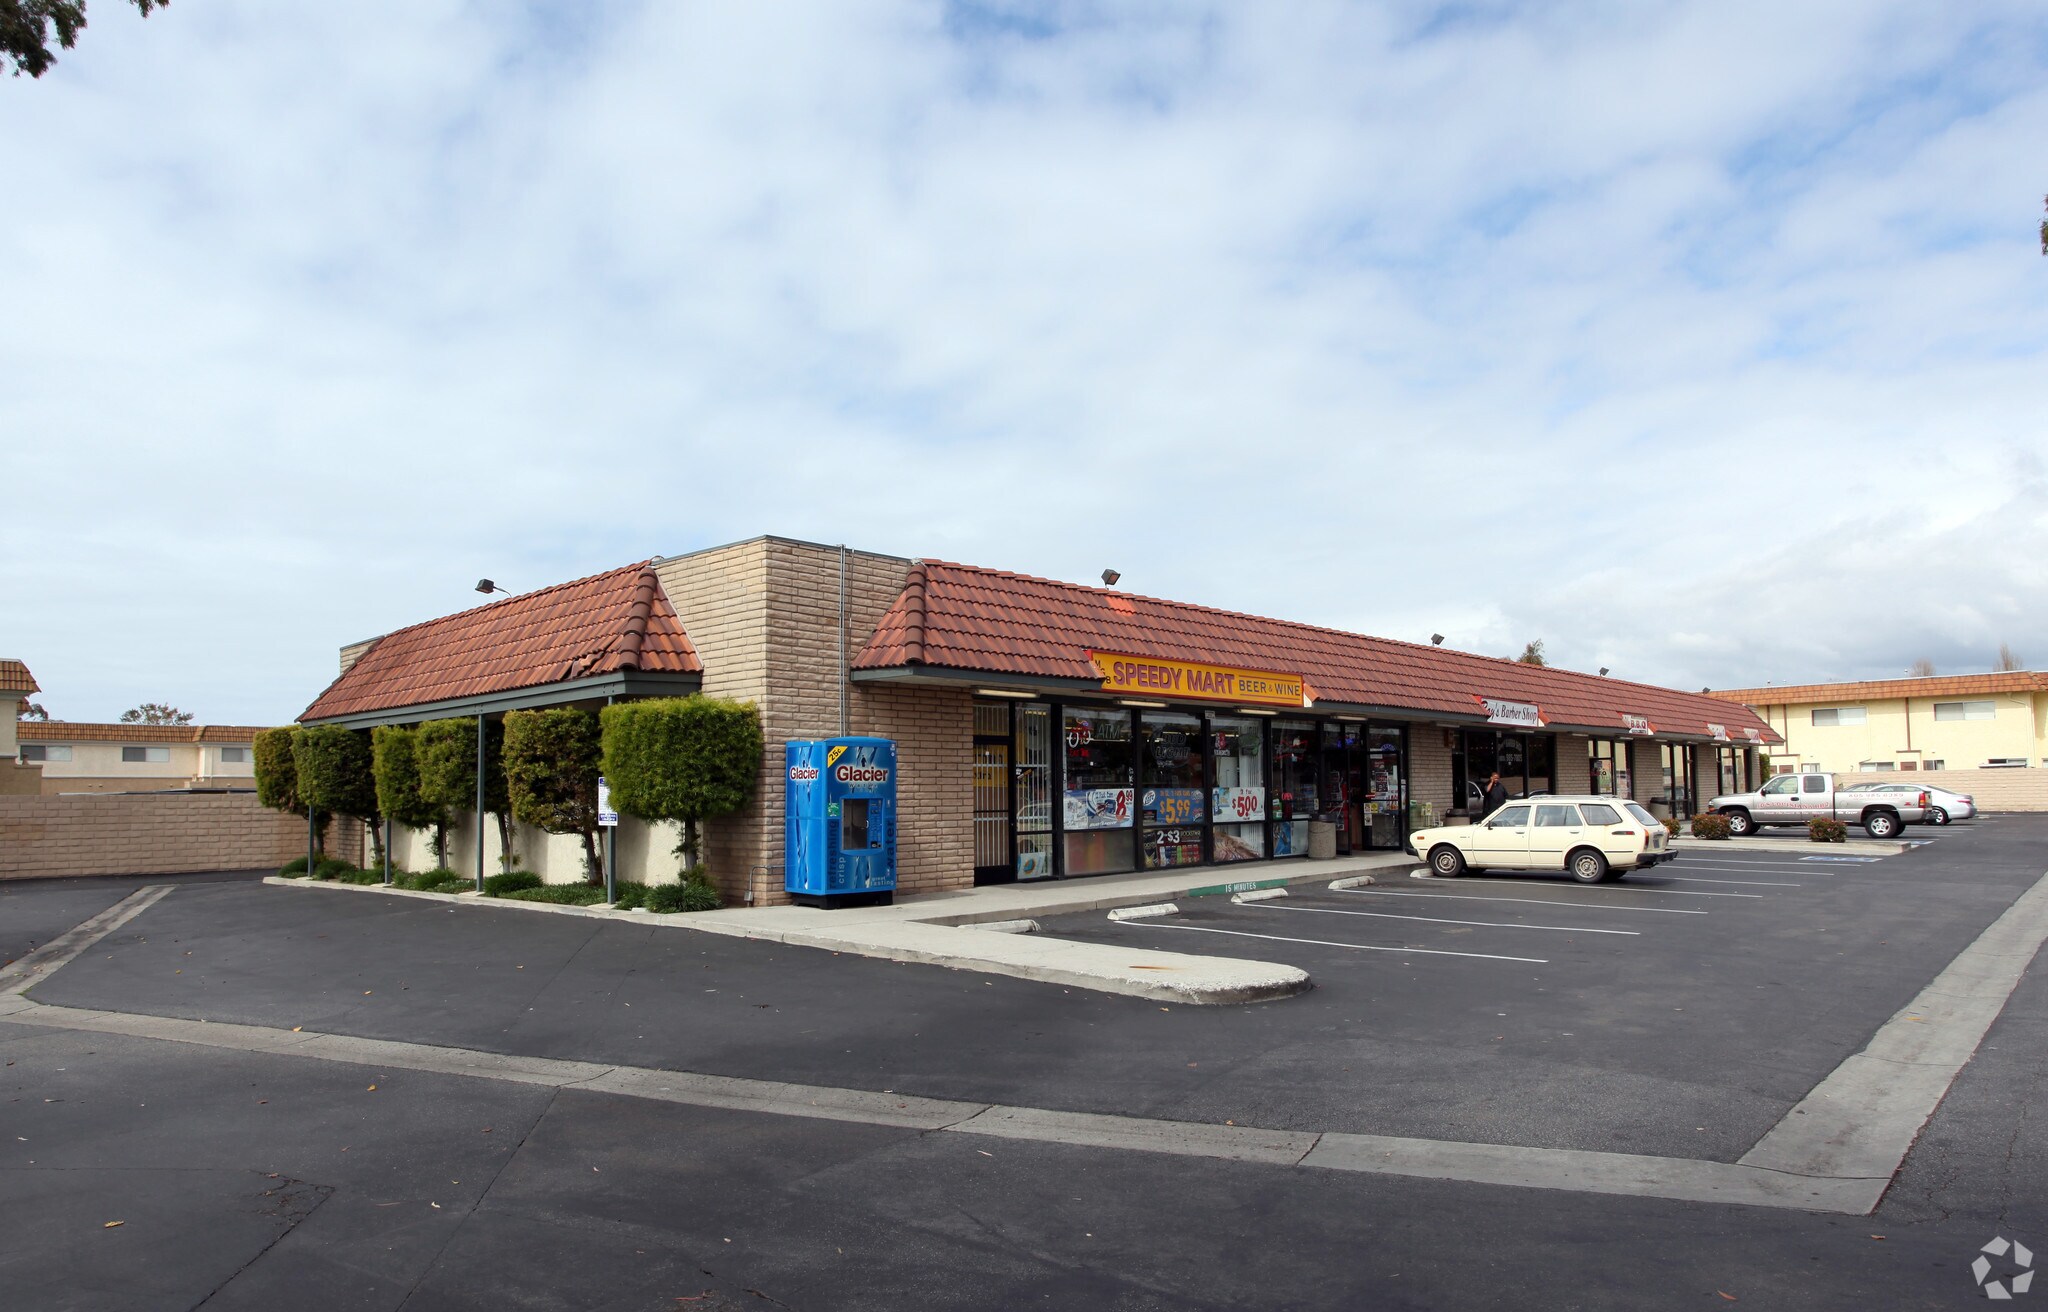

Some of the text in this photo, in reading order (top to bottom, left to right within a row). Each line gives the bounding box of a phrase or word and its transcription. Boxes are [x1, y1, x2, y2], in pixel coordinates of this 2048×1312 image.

[1113, 661, 1182, 690] SPEEDY
[1187, 669, 1235, 694] MART
[1239, 679, 1267, 693] BEER
[1275, 683, 1300, 697] WINE
[1501, 704, 1521, 720] Barber
[1522, 706, 1537, 724] Shop
[1097, 723, 1120, 739] ATM
[790, 767, 818, 780] Glacier
[836, 765, 888, 782] Glacier
[828, 820, 840, 889] refreshing
[885, 820, 895, 869] water
[837, 857, 846, 884] crisp
[1225, 881, 1257, 893] 15 MINUTES
